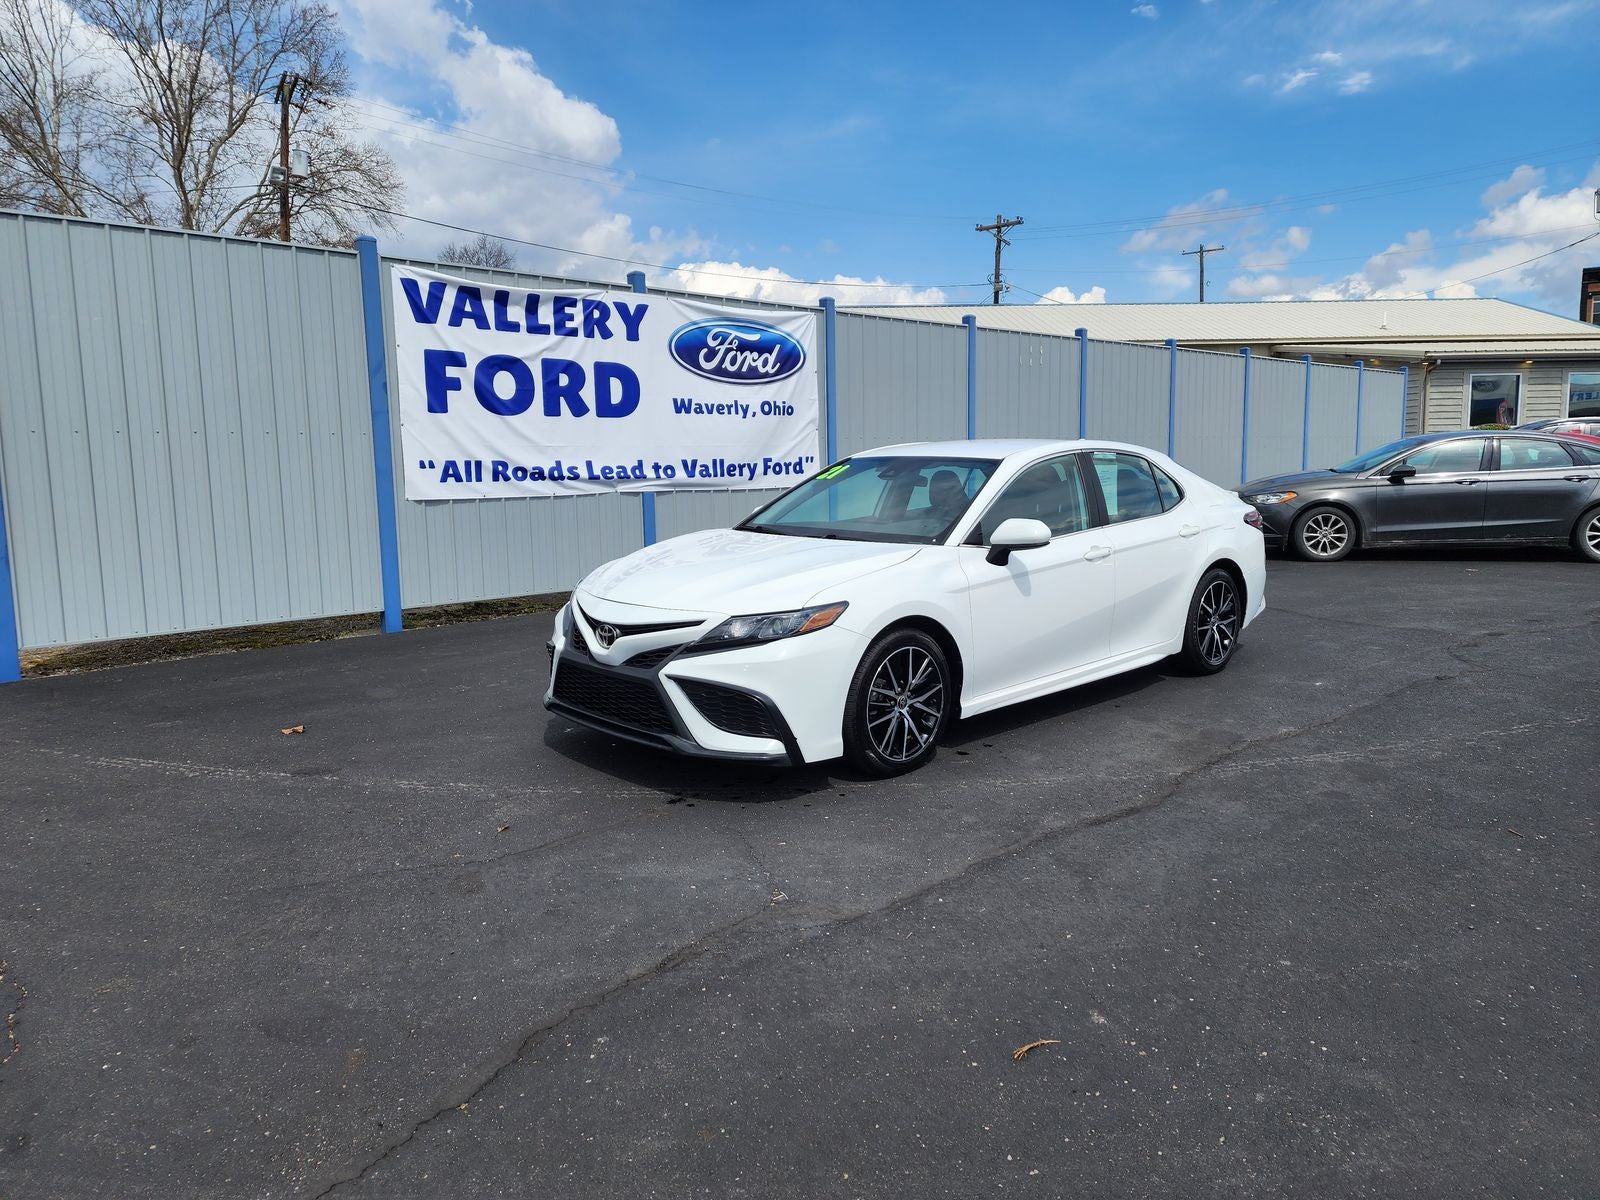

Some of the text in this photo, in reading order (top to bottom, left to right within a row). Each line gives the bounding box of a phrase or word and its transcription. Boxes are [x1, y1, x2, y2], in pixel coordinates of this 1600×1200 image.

[400, 277, 649, 342] VALLERY
[699, 327, 781, 374] Ford
[424, 349, 641, 418] FORD
[672, 397, 795, 419] Waverly, Ohio
[491, 460, 581, 482] Roads
[585, 459, 648, 481] Lead
[651, 462, 676, 480] to
[681, 458, 758, 481] Vallery
